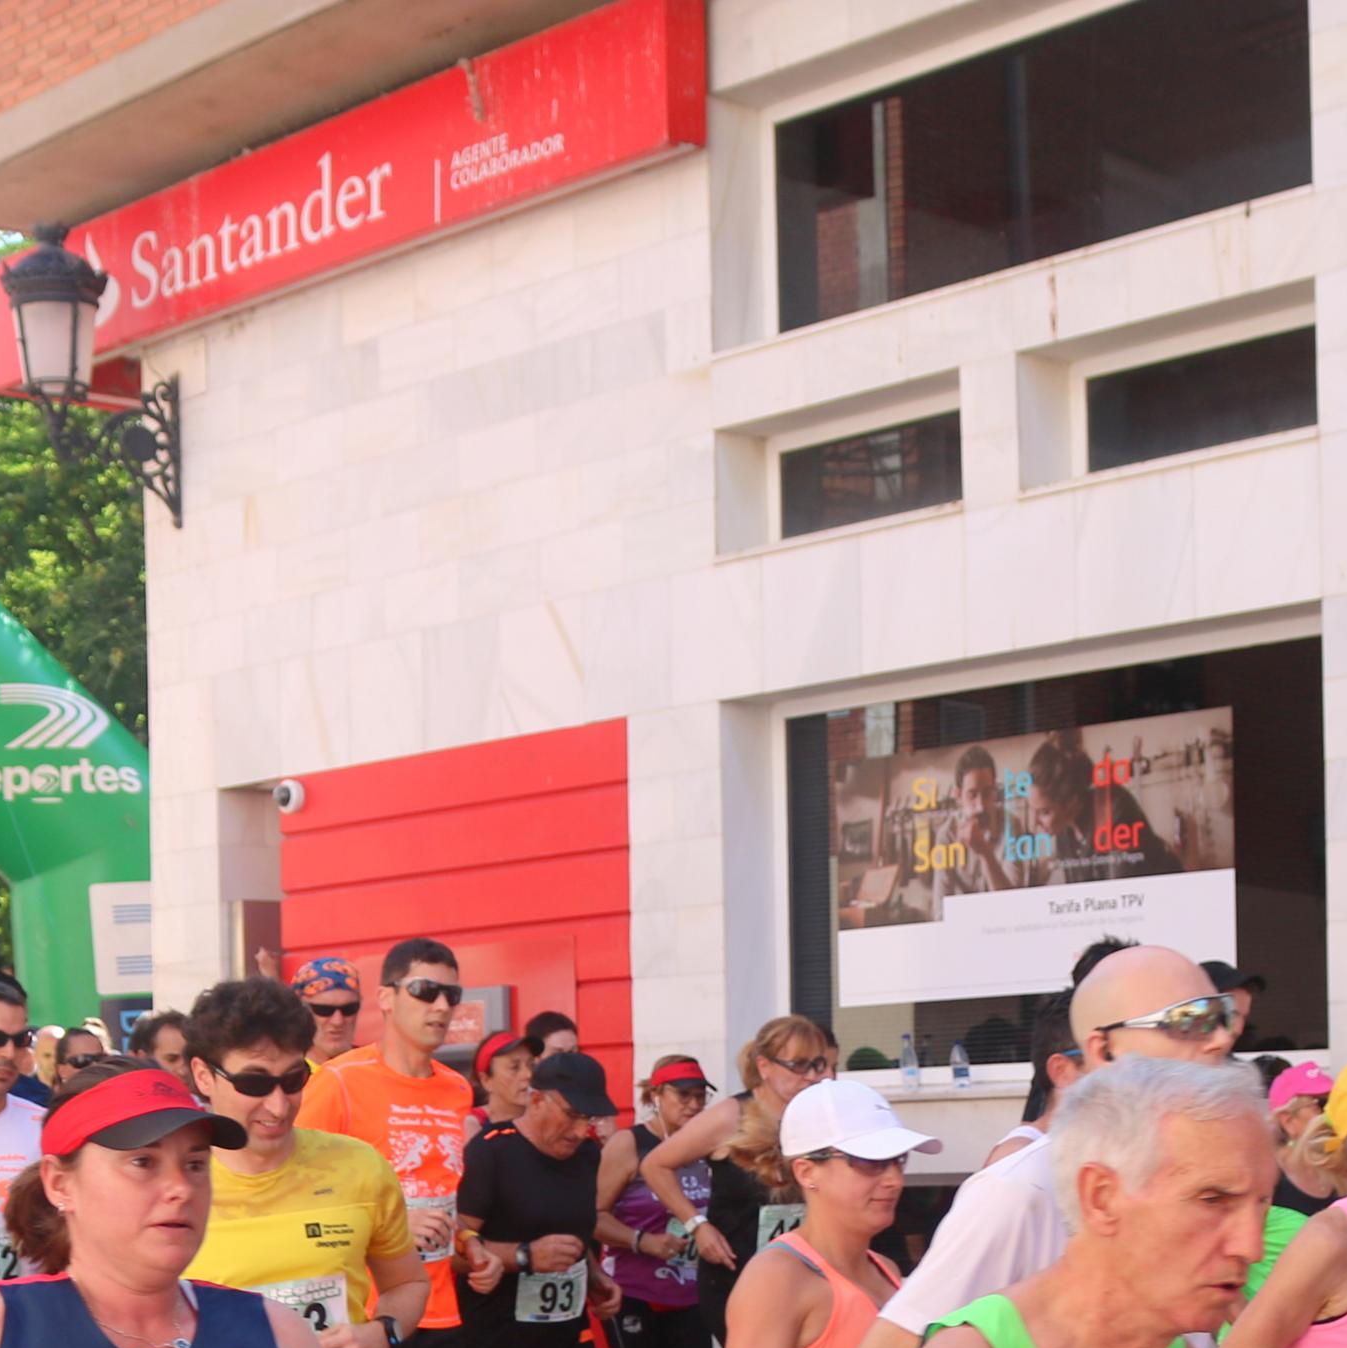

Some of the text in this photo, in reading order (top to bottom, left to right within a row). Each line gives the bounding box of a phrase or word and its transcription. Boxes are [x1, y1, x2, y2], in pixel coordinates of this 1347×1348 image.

[450, 132, 508, 169] AGENTE
[450, 133, 565, 191] COLABORADOR
[131, 151, 393, 309] Santander
[911, 752, 1132, 812] Si te da
[912, 818, 1144, 874] San tan der
[1048, 894, 1145, 914] Tarifa Plana TPV
[539, 1279, 576, 1312] 93
